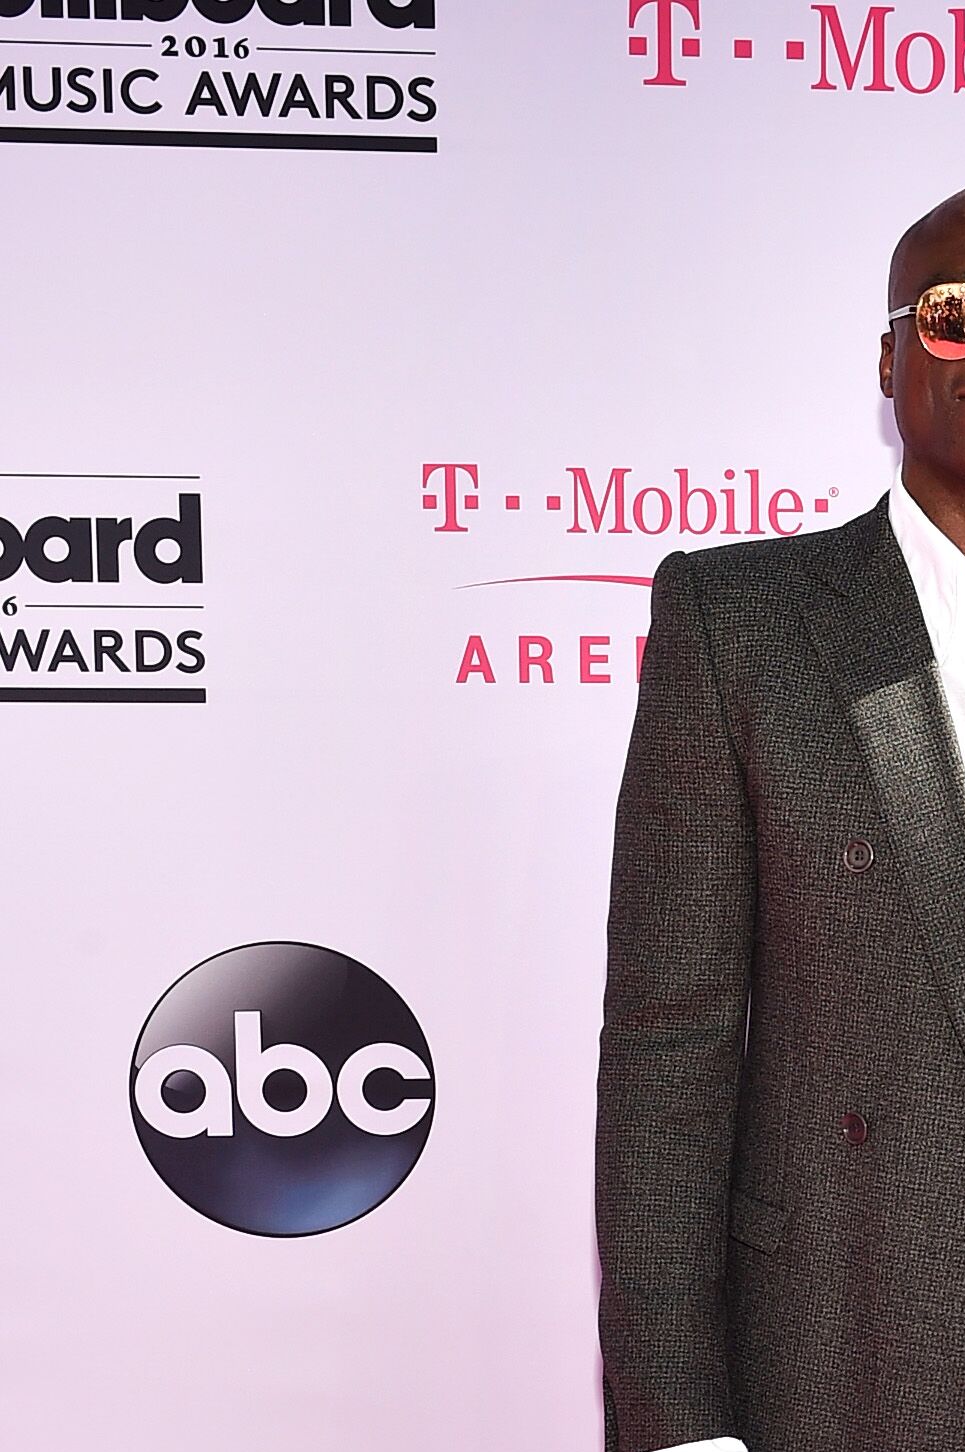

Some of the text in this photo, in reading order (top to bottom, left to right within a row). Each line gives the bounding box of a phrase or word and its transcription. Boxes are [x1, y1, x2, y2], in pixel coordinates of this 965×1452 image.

[161, 35, 249, 59] 2016
[185, 71, 436, 122] AWARDS
[456, 636, 655, 683] ARE
[135, 1011, 431, 1137] abc
